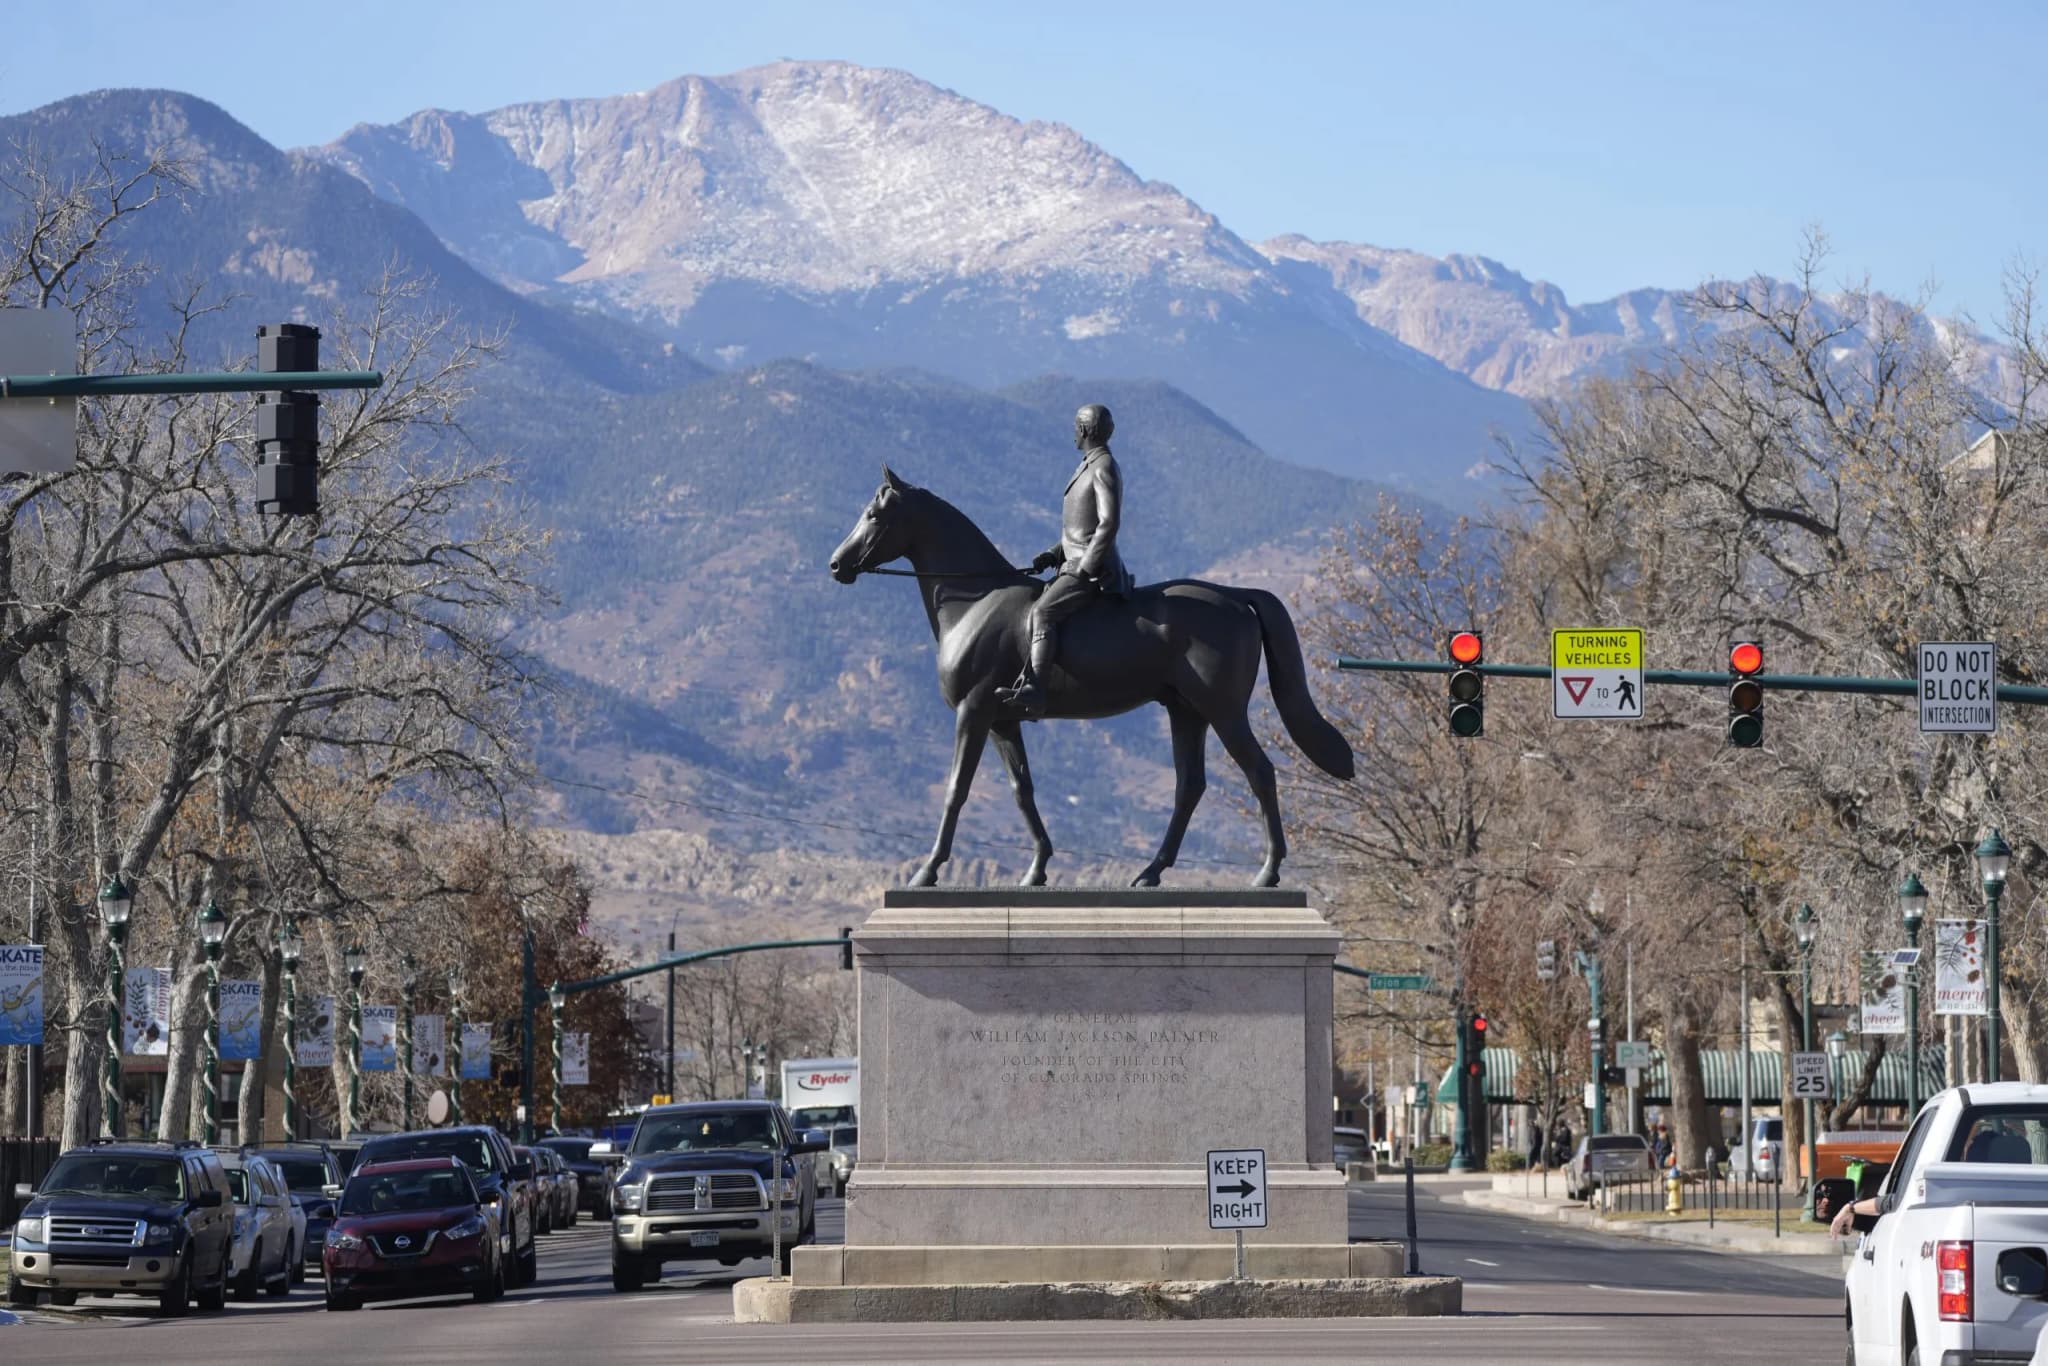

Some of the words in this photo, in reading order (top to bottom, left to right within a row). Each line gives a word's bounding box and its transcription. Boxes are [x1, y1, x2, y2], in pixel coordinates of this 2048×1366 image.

[1568, 636, 1628, 649] TURNING
[1565, 652, 1632, 665] VEHICLES
[1924, 651, 1948, 673] DO
[1956, 651, 1990, 673] NOT
[1597, 687, 1609, 699] TO
[1924, 679, 1990, 700] BLOCK
[1924, 707, 1991, 724] INTERSECTION
[0, 949, 42, 963] KATE
[220, 983, 260, 996] SKATE
[1937, 990, 1985, 1003] merry
[363, 1008, 395, 1018] SKATE
[1863, 1013, 1900, 1025] cheer
[971, 1030, 1047, 1043] WILLIAM
[1150, 1030, 1219, 1043] PALMER
[1002, 1055, 1077, 1066] FOUNDER
[811, 1073, 851, 1086] Ryder
[1796, 1076, 1825, 1092] 25
[1214, 1160, 1258, 1175] KEEP
[1213, 1203, 1263, 1219] RIGHT
